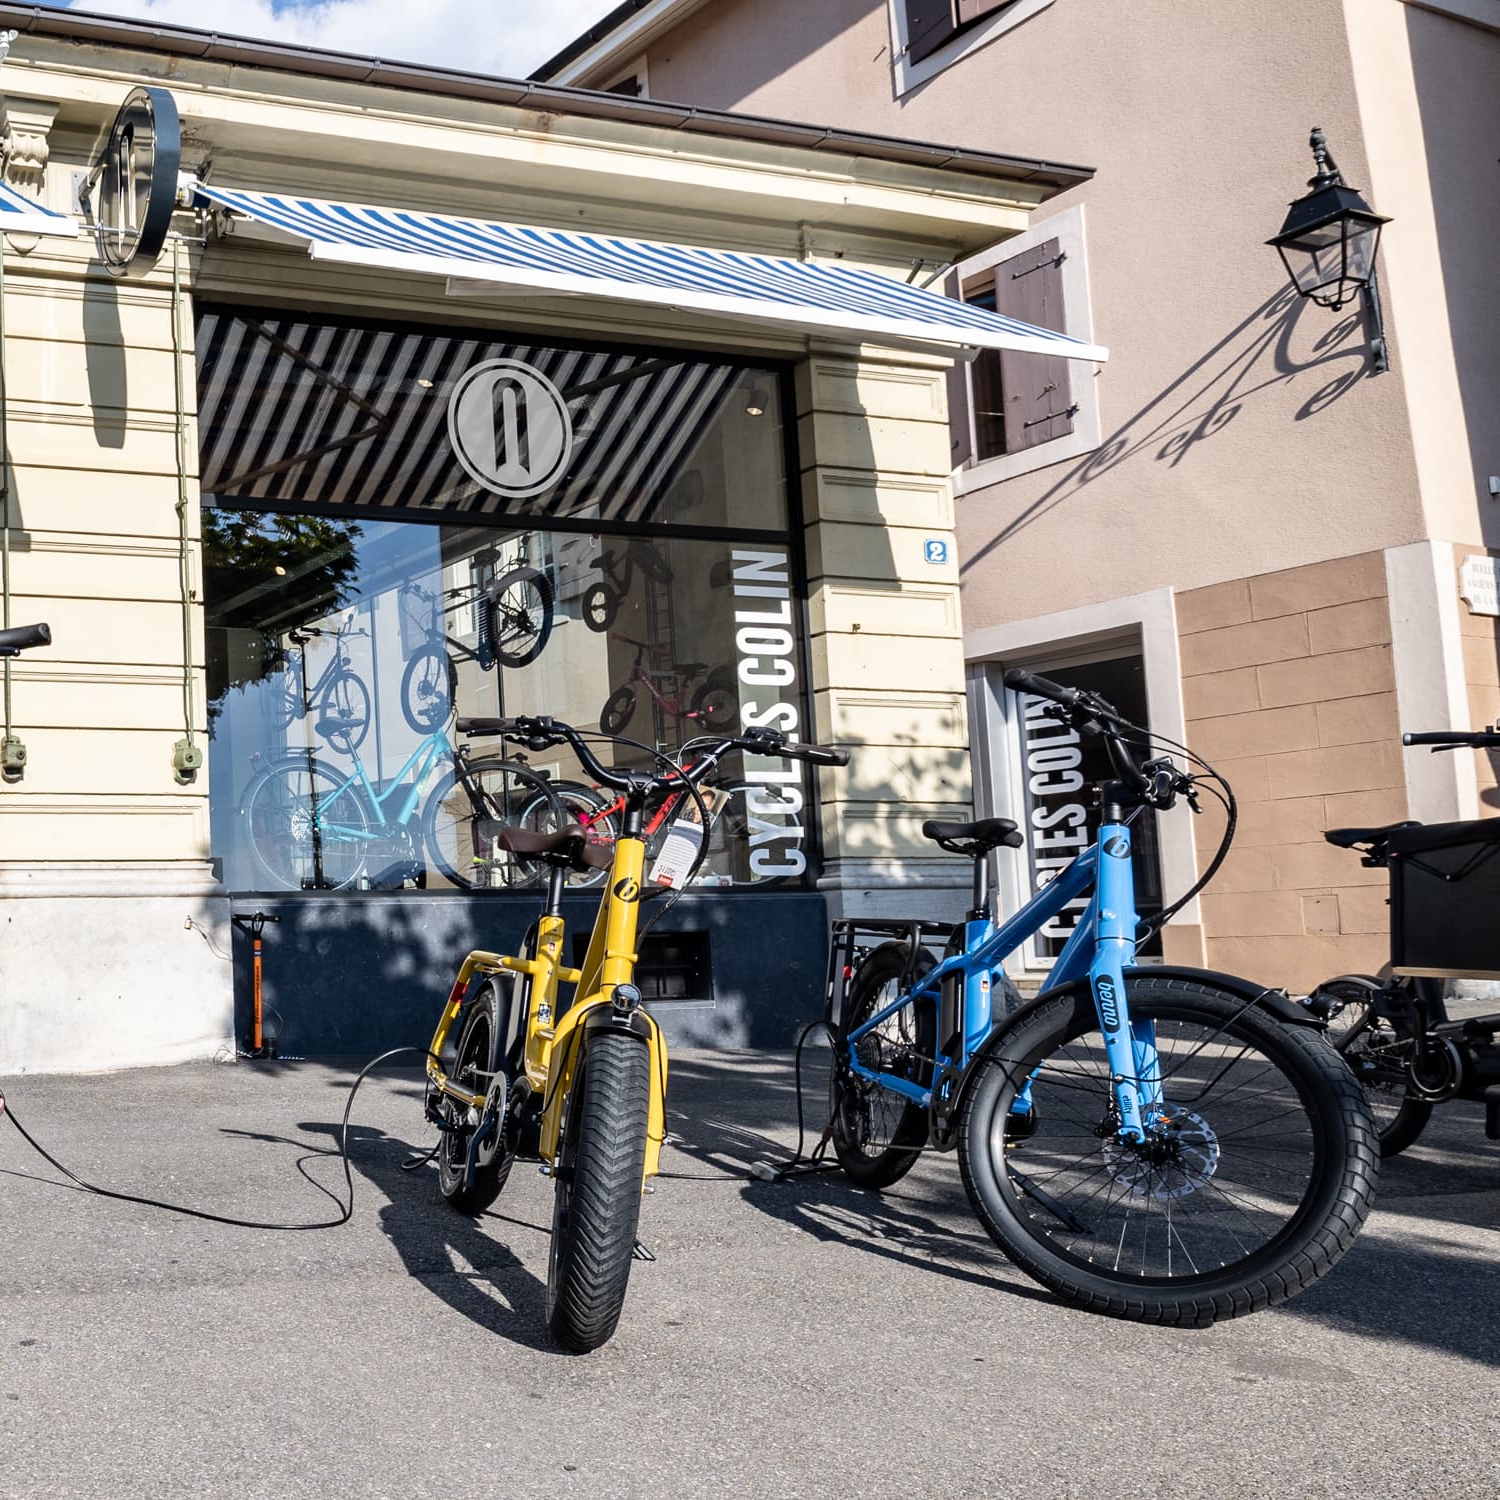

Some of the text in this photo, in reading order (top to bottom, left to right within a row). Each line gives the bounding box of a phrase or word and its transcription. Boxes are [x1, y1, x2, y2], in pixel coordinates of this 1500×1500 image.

[930, 543, 944, 560] 2
[731, 550, 795, 686] COLIN
[1031, 803, 1093, 938] CLES
[1098, 982, 1118, 1026] benno
